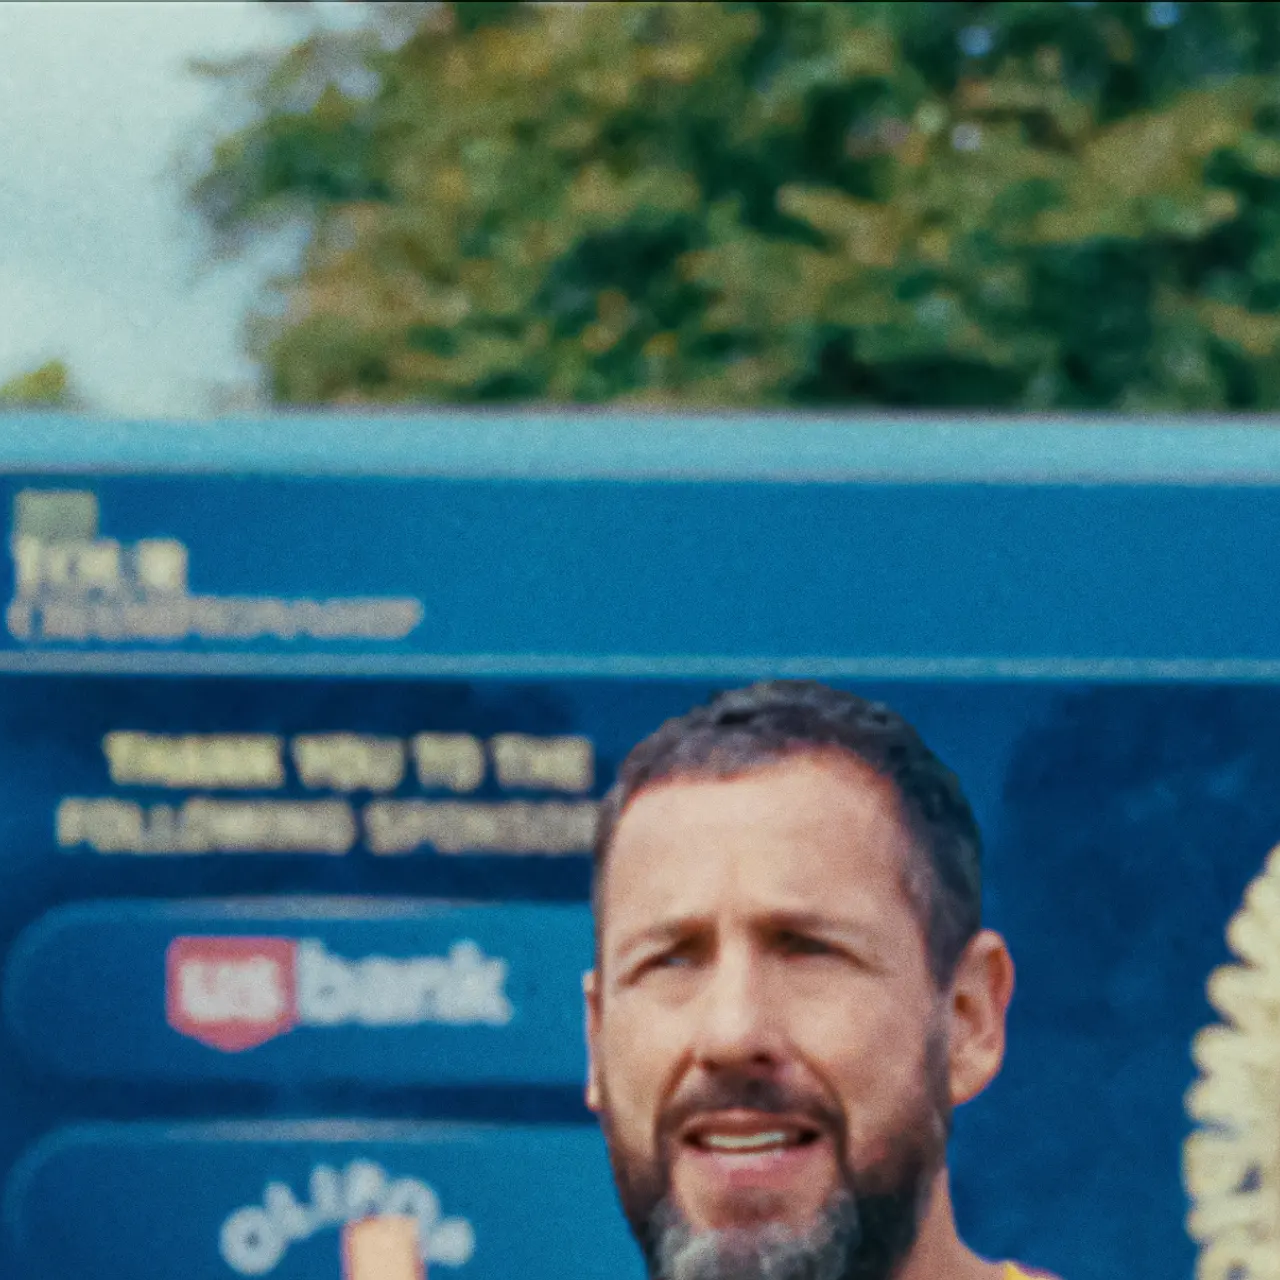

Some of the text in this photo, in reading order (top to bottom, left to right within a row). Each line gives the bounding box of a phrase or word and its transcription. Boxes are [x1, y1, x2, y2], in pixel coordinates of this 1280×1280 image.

[104, 731, 595, 791] THANK YOU TO THE
[55, 798, 599, 856] FOLLOWING SPONSOR
[297, 937, 514, 1026] bank
